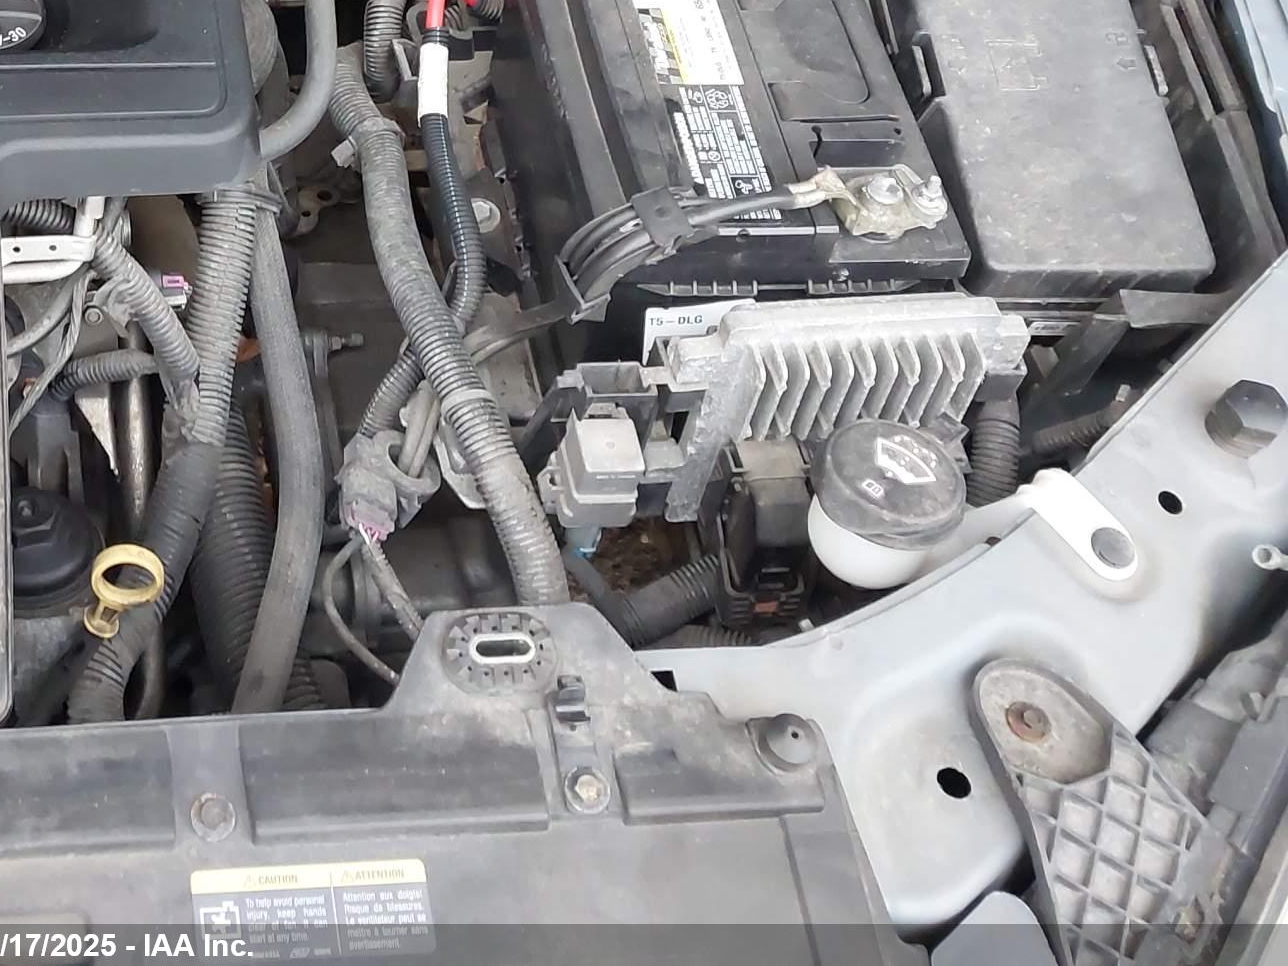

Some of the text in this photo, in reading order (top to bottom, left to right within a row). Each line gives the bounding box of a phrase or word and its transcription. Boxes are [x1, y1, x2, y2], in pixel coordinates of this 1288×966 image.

[258, 874, 298, 885] CAUTION
[355, 868, 404, 881] ATTENTION
[255, 897, 272, 908] help
[273, 896, 293, 907] avoid
[294, 894, 325, 907] personal
[343, 891, 376, 903] Attention
[379, 891, 393, 901] aux
[276, 909, 296, 920] keep
[303, 906, 327, 917] hands
[373, 902, 383, 912] de
[345, 913, 427, 925] Le ventilateur peut se
